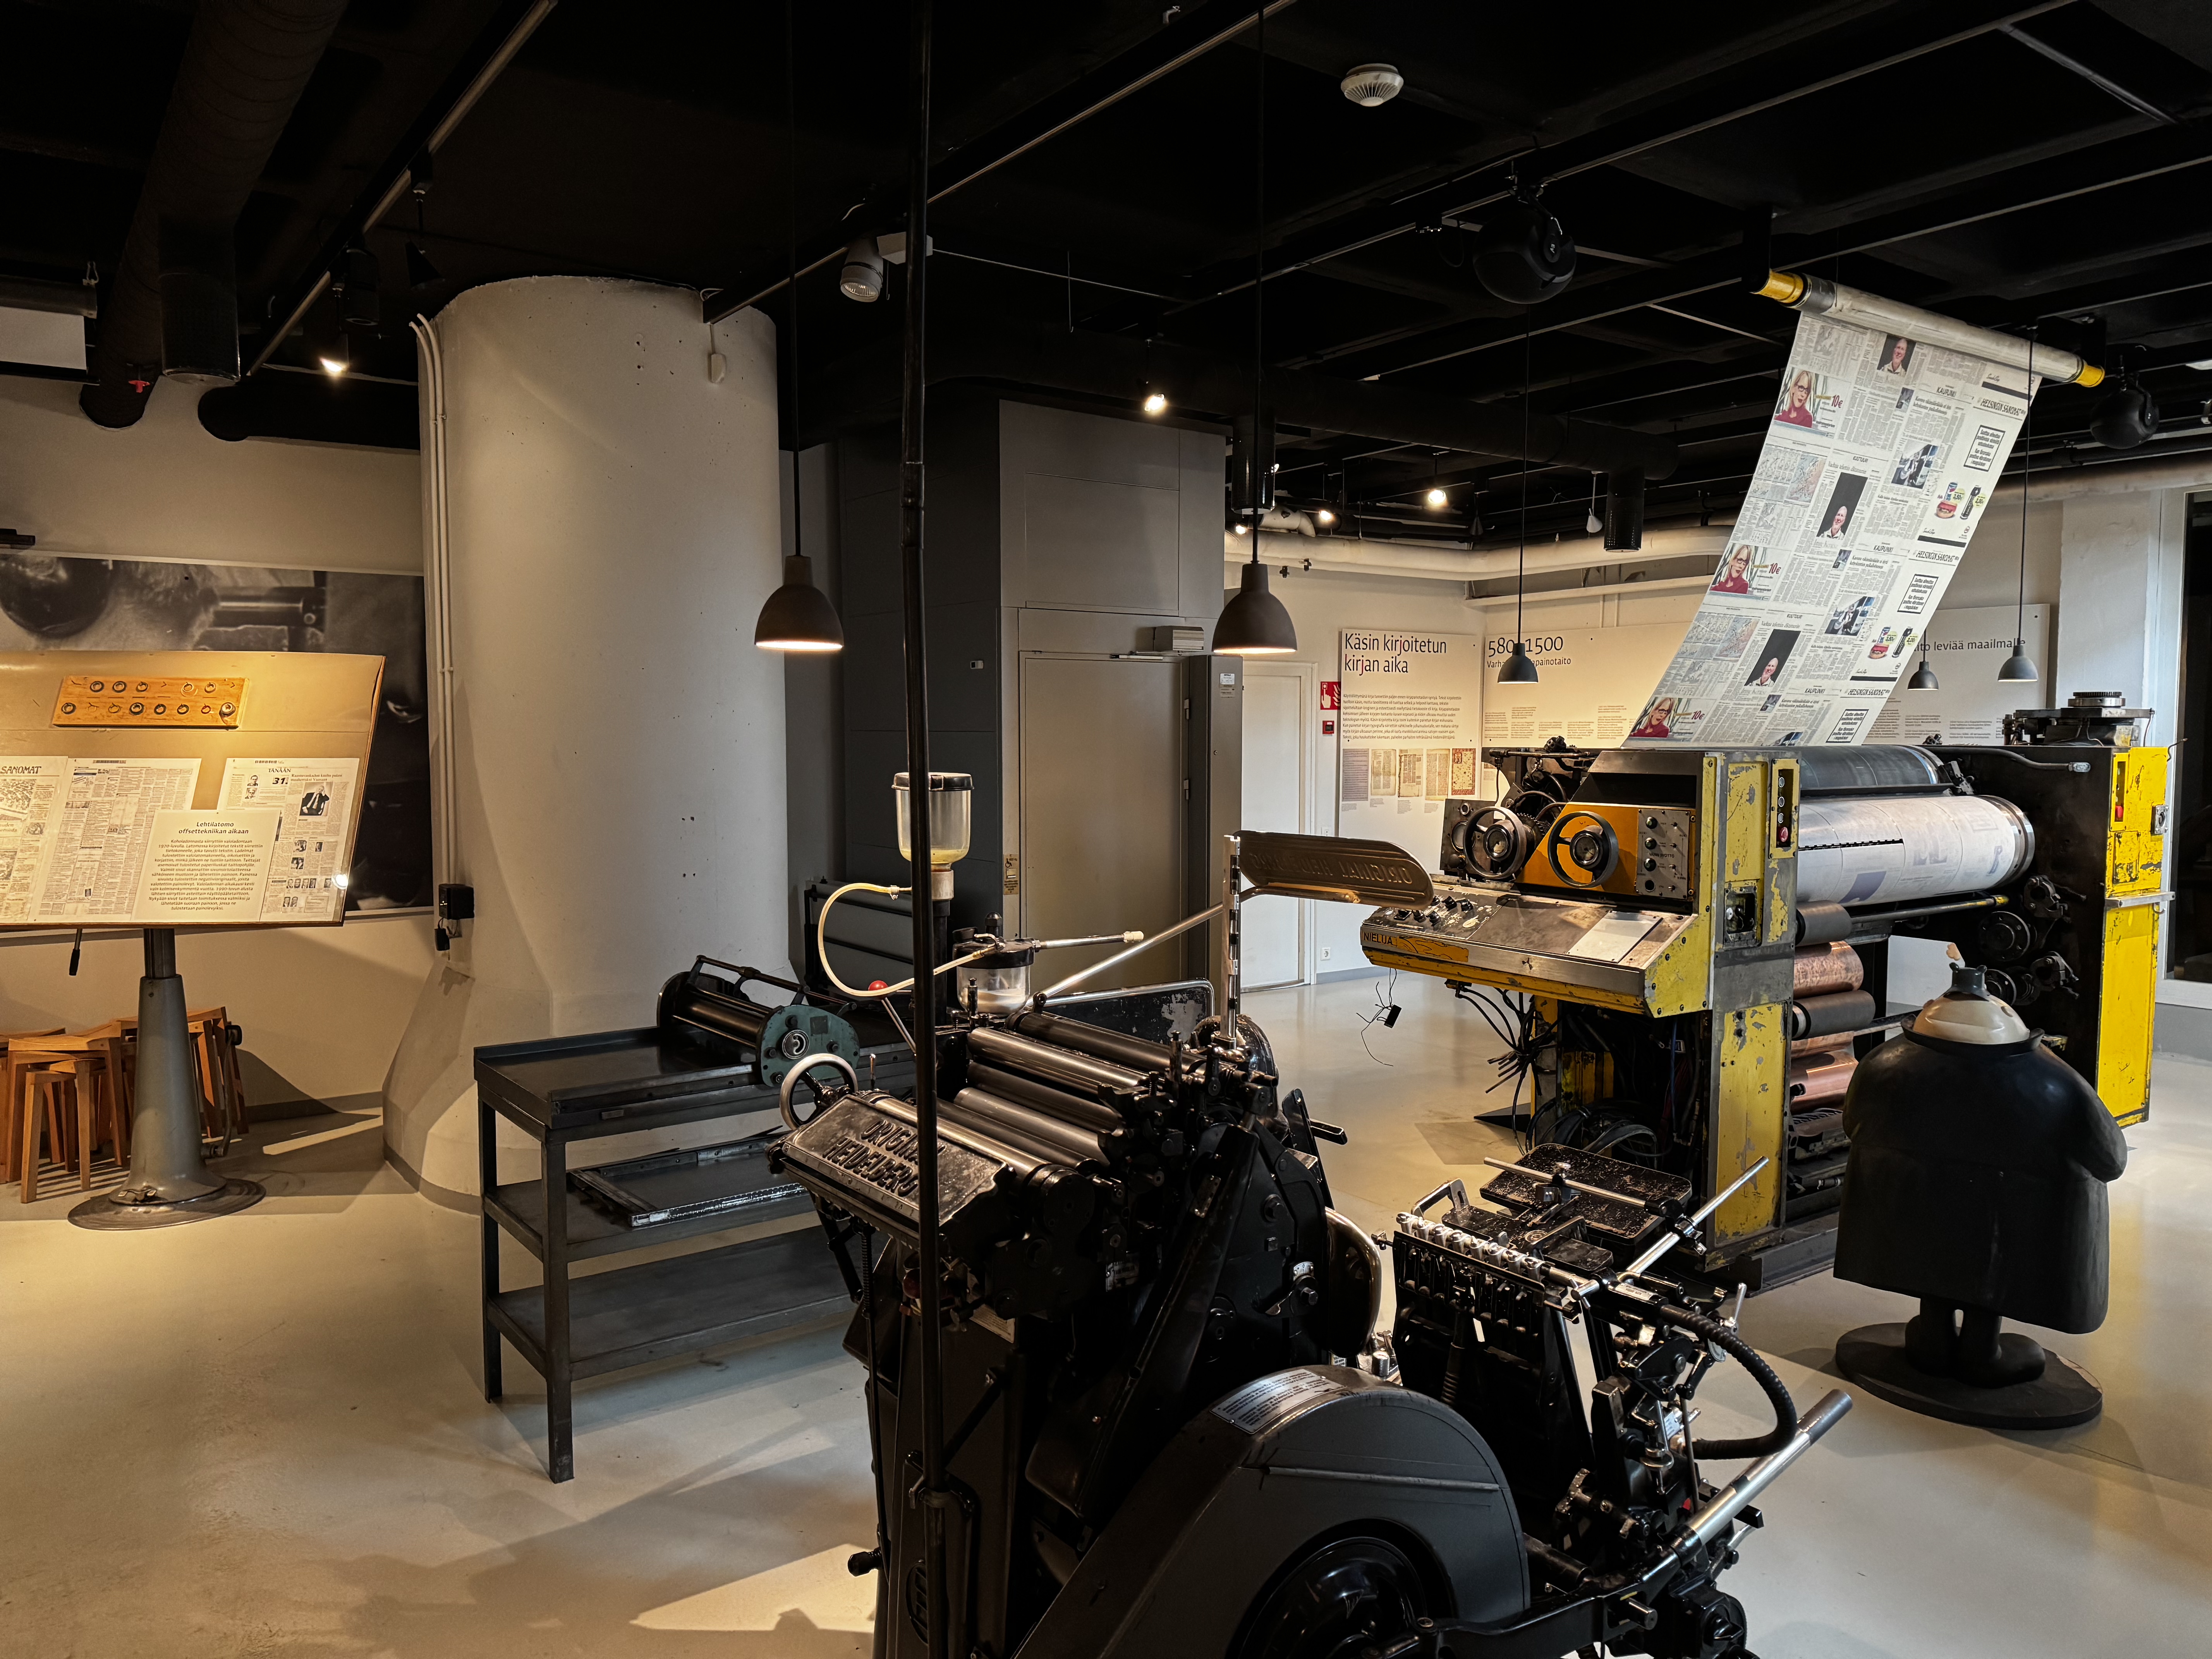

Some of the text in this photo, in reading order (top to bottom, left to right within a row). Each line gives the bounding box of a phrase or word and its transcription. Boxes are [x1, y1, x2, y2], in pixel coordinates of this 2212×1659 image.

[1831, 394, 1843, 408] 10€
[1769, 563, 1781, 574] 10€
[1345, 633, 1447, 656] Käsin kirjoitetun
[1934, 641, 1964, 651] leviää
[1344, 654, 1409, 675] kirjan aika
[1691, 710, 1705, 720] 10€
[0, 766, 41, 774] SANOMAT
